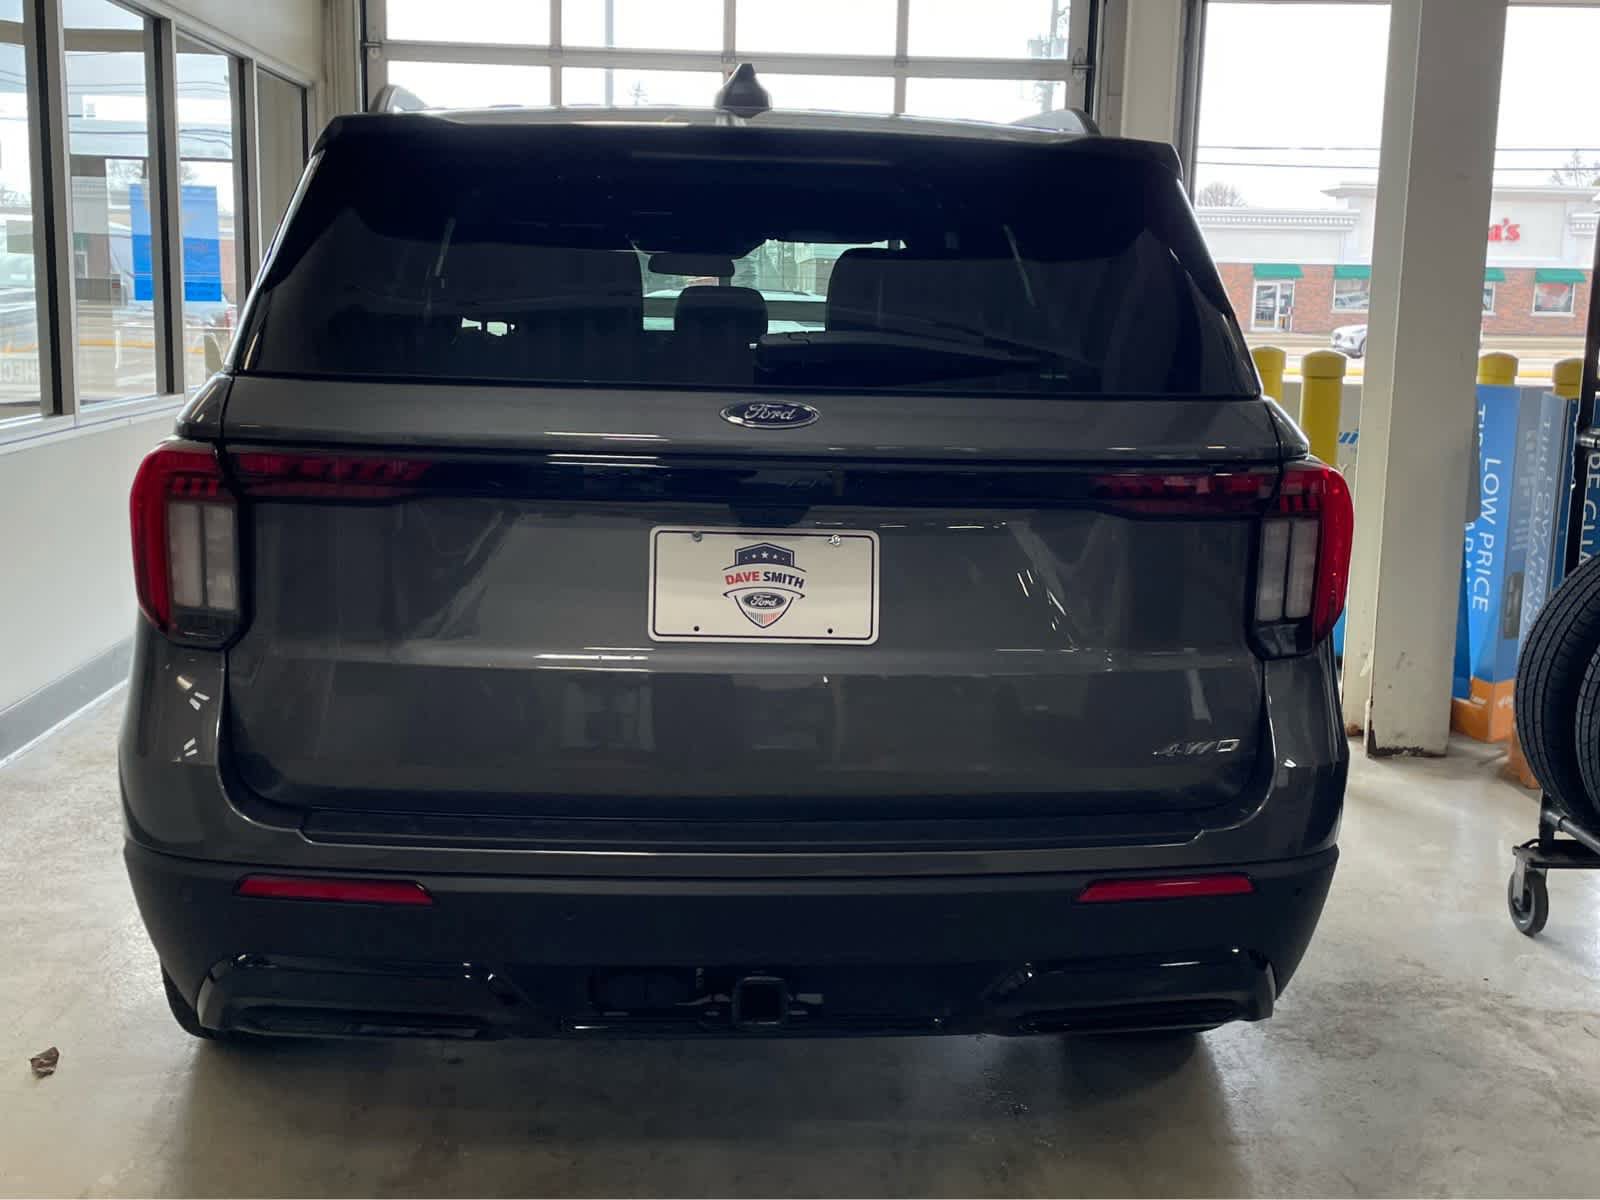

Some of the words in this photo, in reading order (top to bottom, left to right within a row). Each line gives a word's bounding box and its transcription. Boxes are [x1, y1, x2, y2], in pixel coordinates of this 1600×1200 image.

[744, 404, 796, 419] Ford
[1480, 457, 1502, 525] LOW
[725, 571, 760, 585] DAVE
[763, 571, 805, 589] SMITH
[1472, 531, 1494, 613] PRICE
[750, 594, 778, 607] Ford
